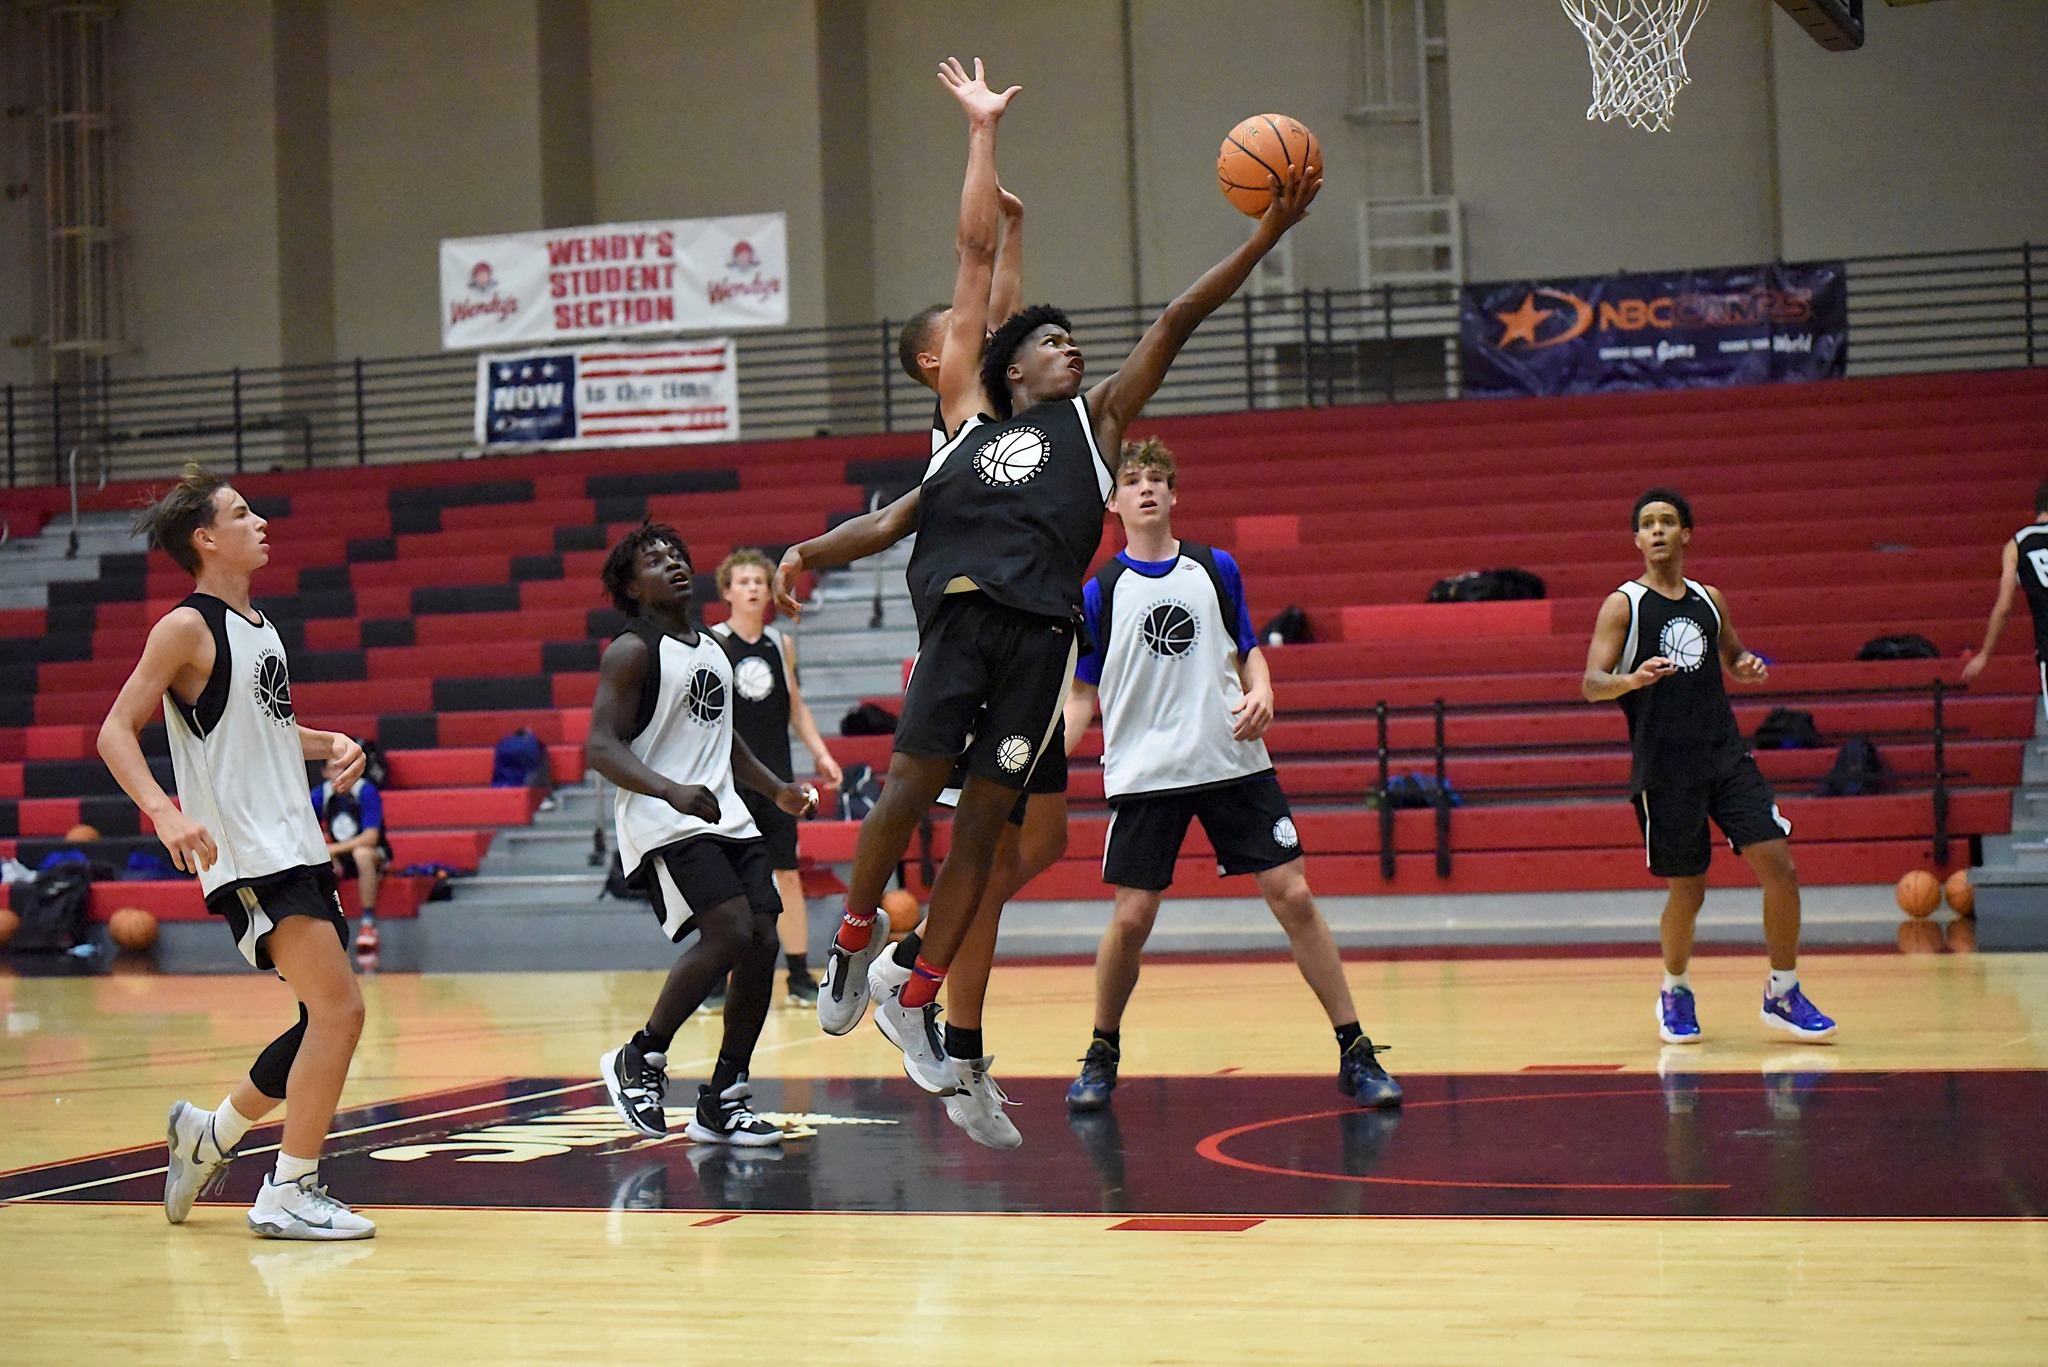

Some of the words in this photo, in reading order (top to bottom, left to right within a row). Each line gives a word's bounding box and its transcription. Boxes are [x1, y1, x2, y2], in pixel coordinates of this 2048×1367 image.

[547, 231, 675, 266] WENDY'S
[549, 264, 677, 298] STUDENT
[554, 297, 675, 330] SECTION
[494, 382, 565, 411] NOW
[973, 440, 994, 469] COLLEGE
[994, 426, 1048, 442] BASKETBALL
[1043, 441, 1051, 463] PREP
[979, 473, 999, 487] NBC
[1004, 467, 1042, 487] CAMPS
[1146, 598, 1195, 614] BASKETBALL
[1148, 650, 1165, 662] NBC
[253, 661, 262, 705] COLLEGE
